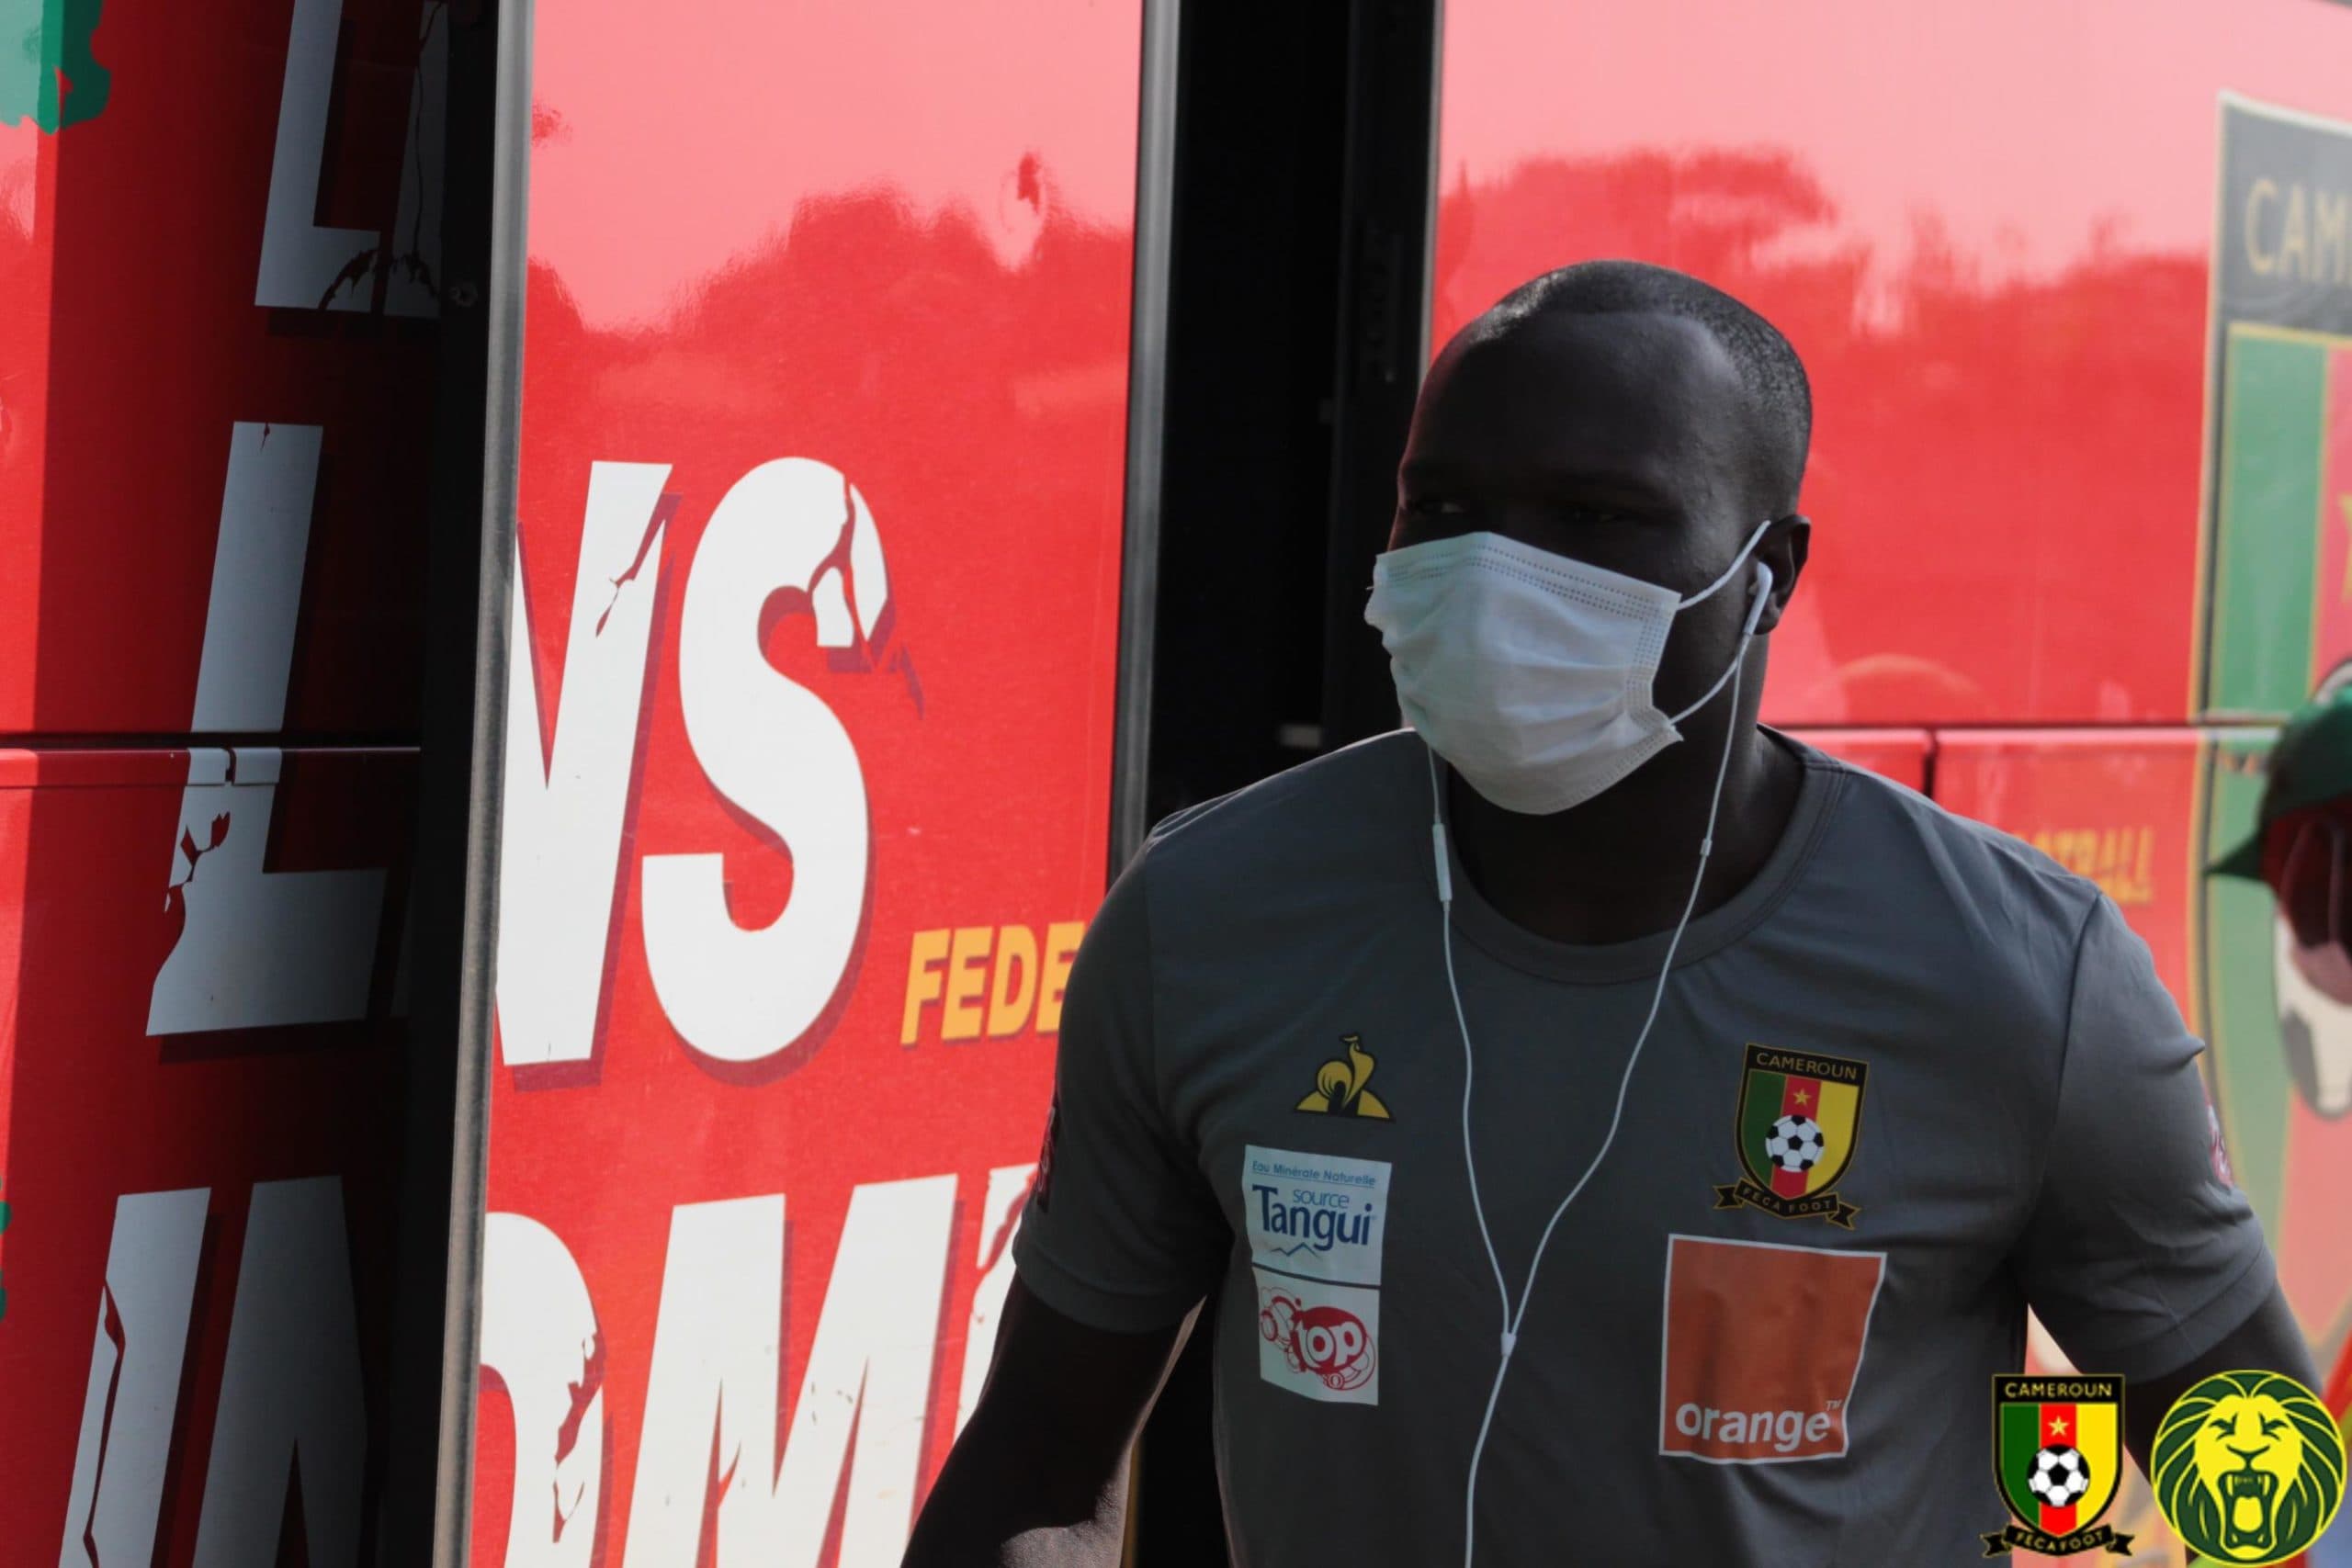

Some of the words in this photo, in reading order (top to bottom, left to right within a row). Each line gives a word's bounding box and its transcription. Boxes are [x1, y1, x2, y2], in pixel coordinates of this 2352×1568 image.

[1756, 1052, 1857, 1080] CAMEROUN
[1252, 1161, 1271, 1172] Eau
[1273, 1163, 1320, 1179] Minérale
[1324, 1170, 1376, 1185] Naturelle
[1293, 1189, 1350, 1209] source
[1252, 1184, 1373, 1251] Tangui
[1675, 1403, 1831, 1452] orange
